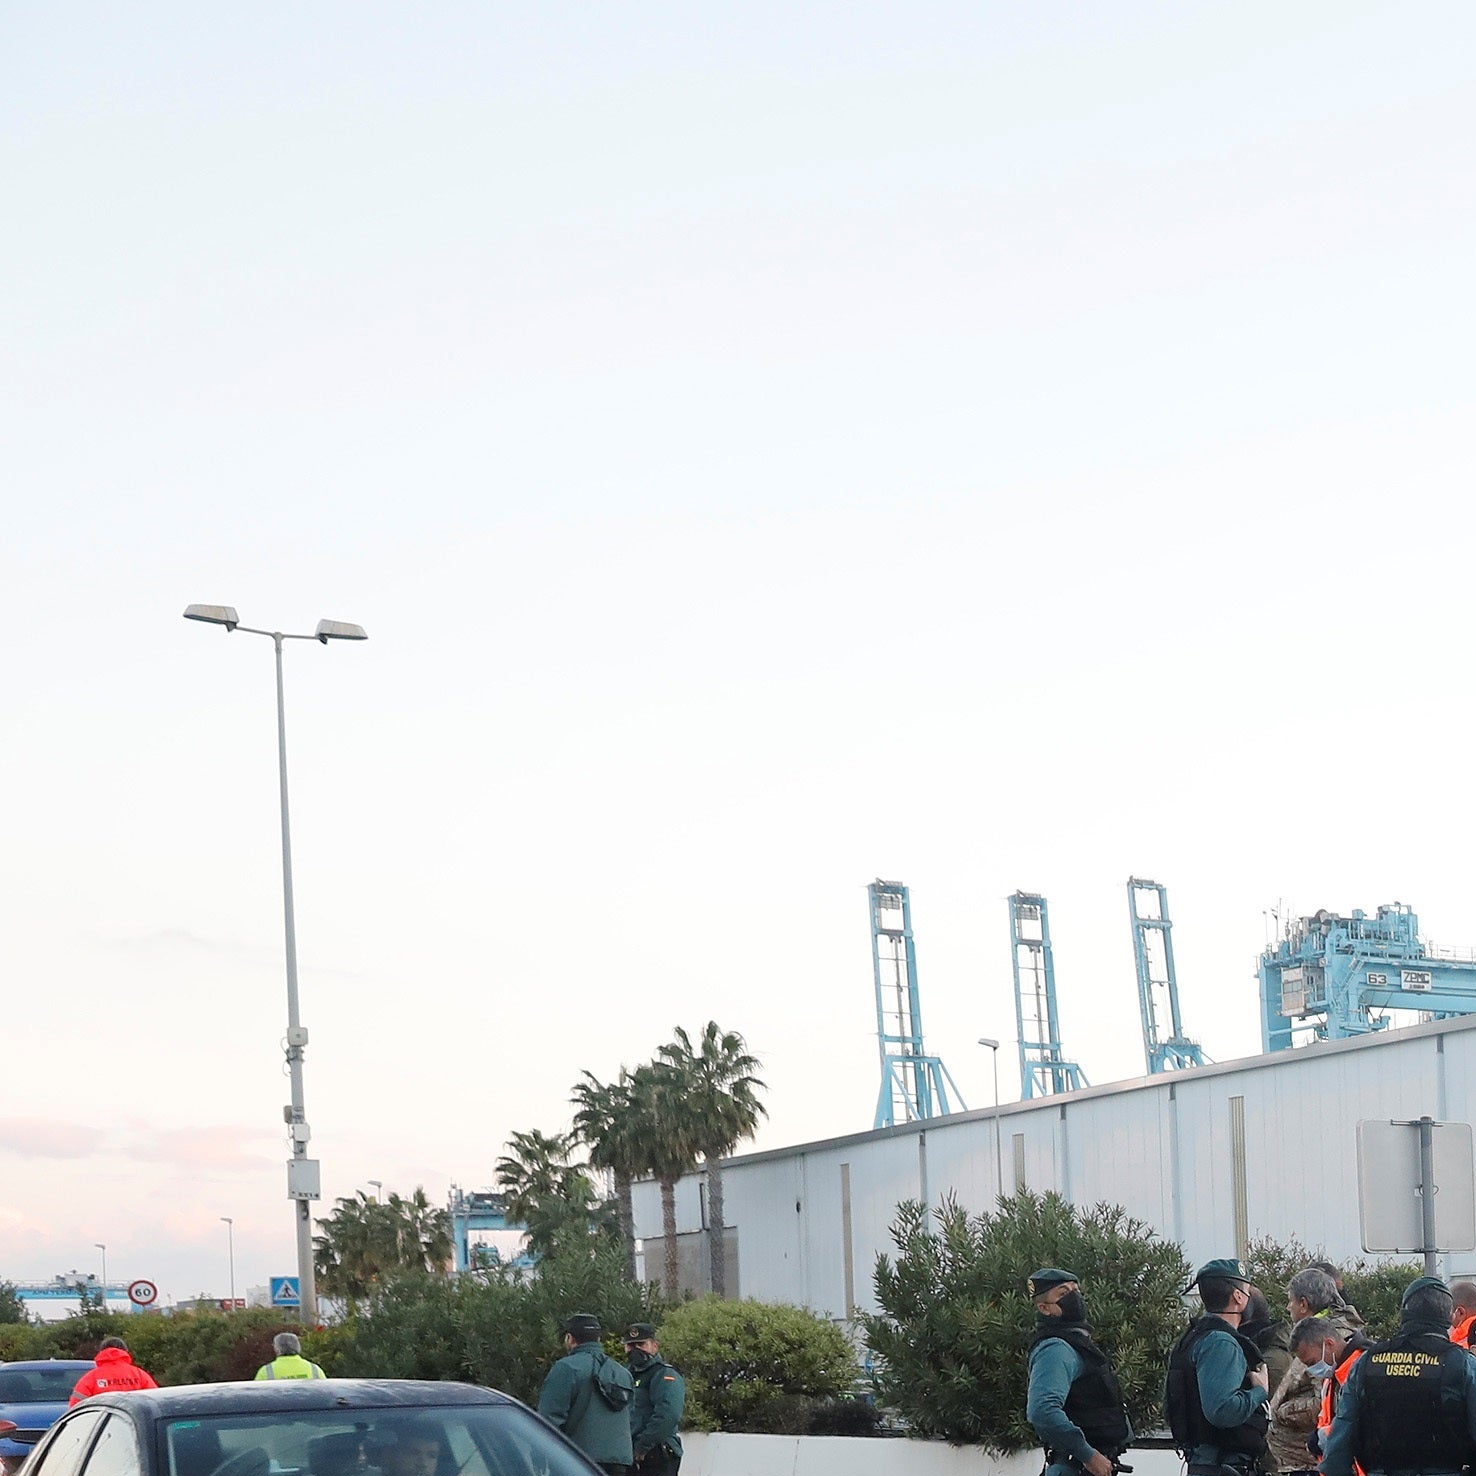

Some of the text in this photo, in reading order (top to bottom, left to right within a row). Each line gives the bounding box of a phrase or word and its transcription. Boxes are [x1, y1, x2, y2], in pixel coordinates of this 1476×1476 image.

[1368, 973, 1387, 985] 63
[1403, 972, 1430, 984] ZPMC
[135, 1287, 152, 1298] 60
[1371, 1352, 1440, 1366] GUARDIA CIVIL
[1386, 1364, 1421, 1377] USECIC
